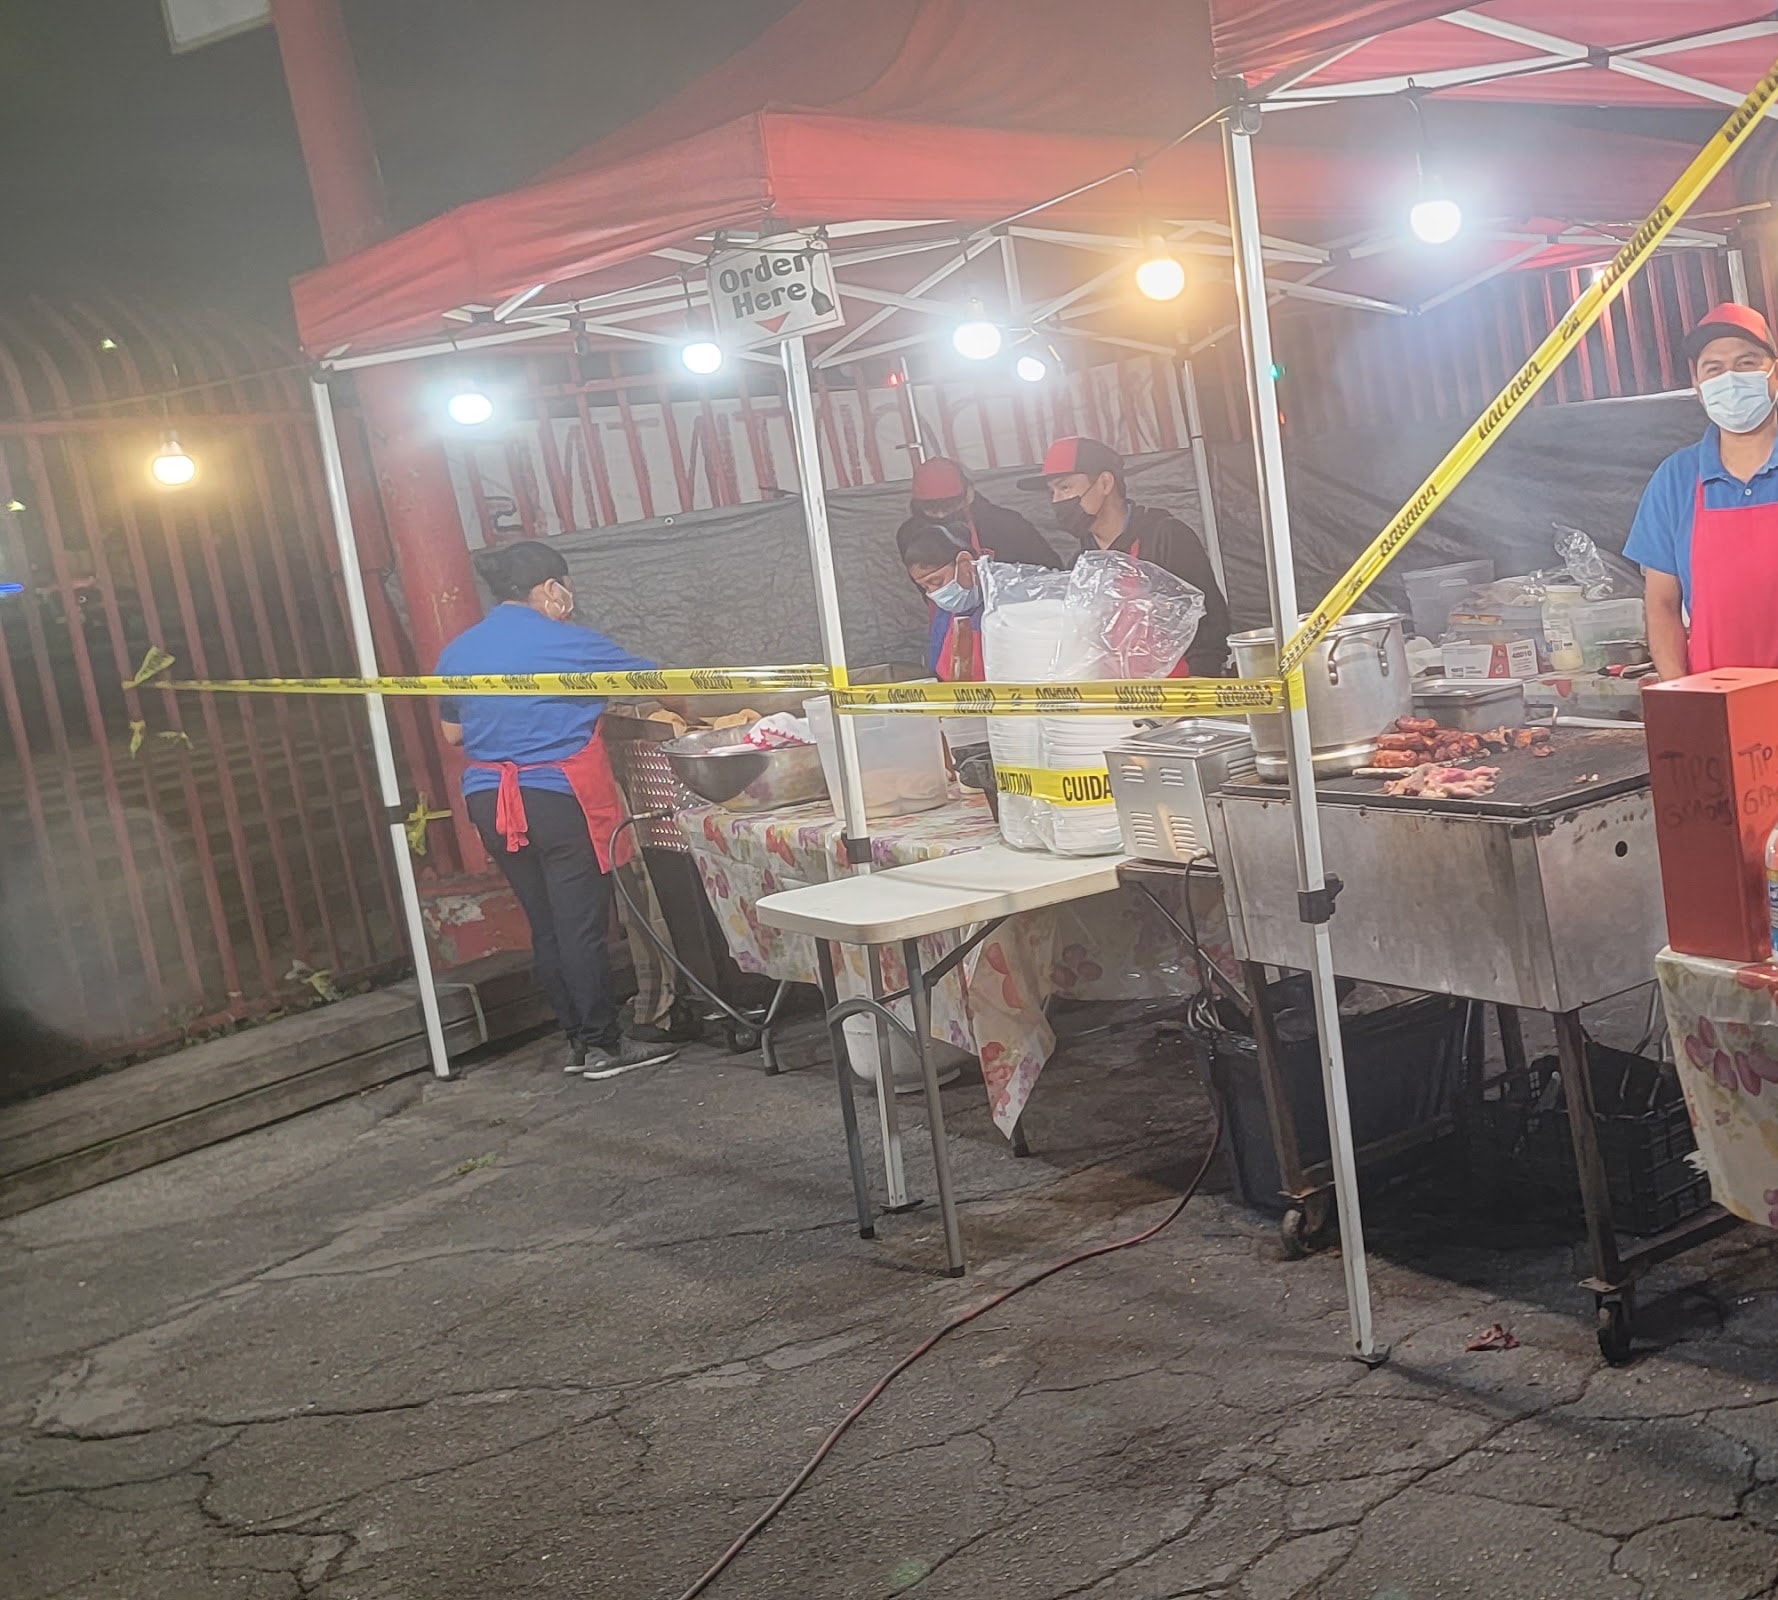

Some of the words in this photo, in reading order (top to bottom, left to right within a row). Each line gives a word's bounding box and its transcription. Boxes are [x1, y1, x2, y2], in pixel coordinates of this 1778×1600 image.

[718, 253, 807, 294] Order
[731, 282, 808, 319] Here
[1062, 773, 1114, 802] CUIDA
